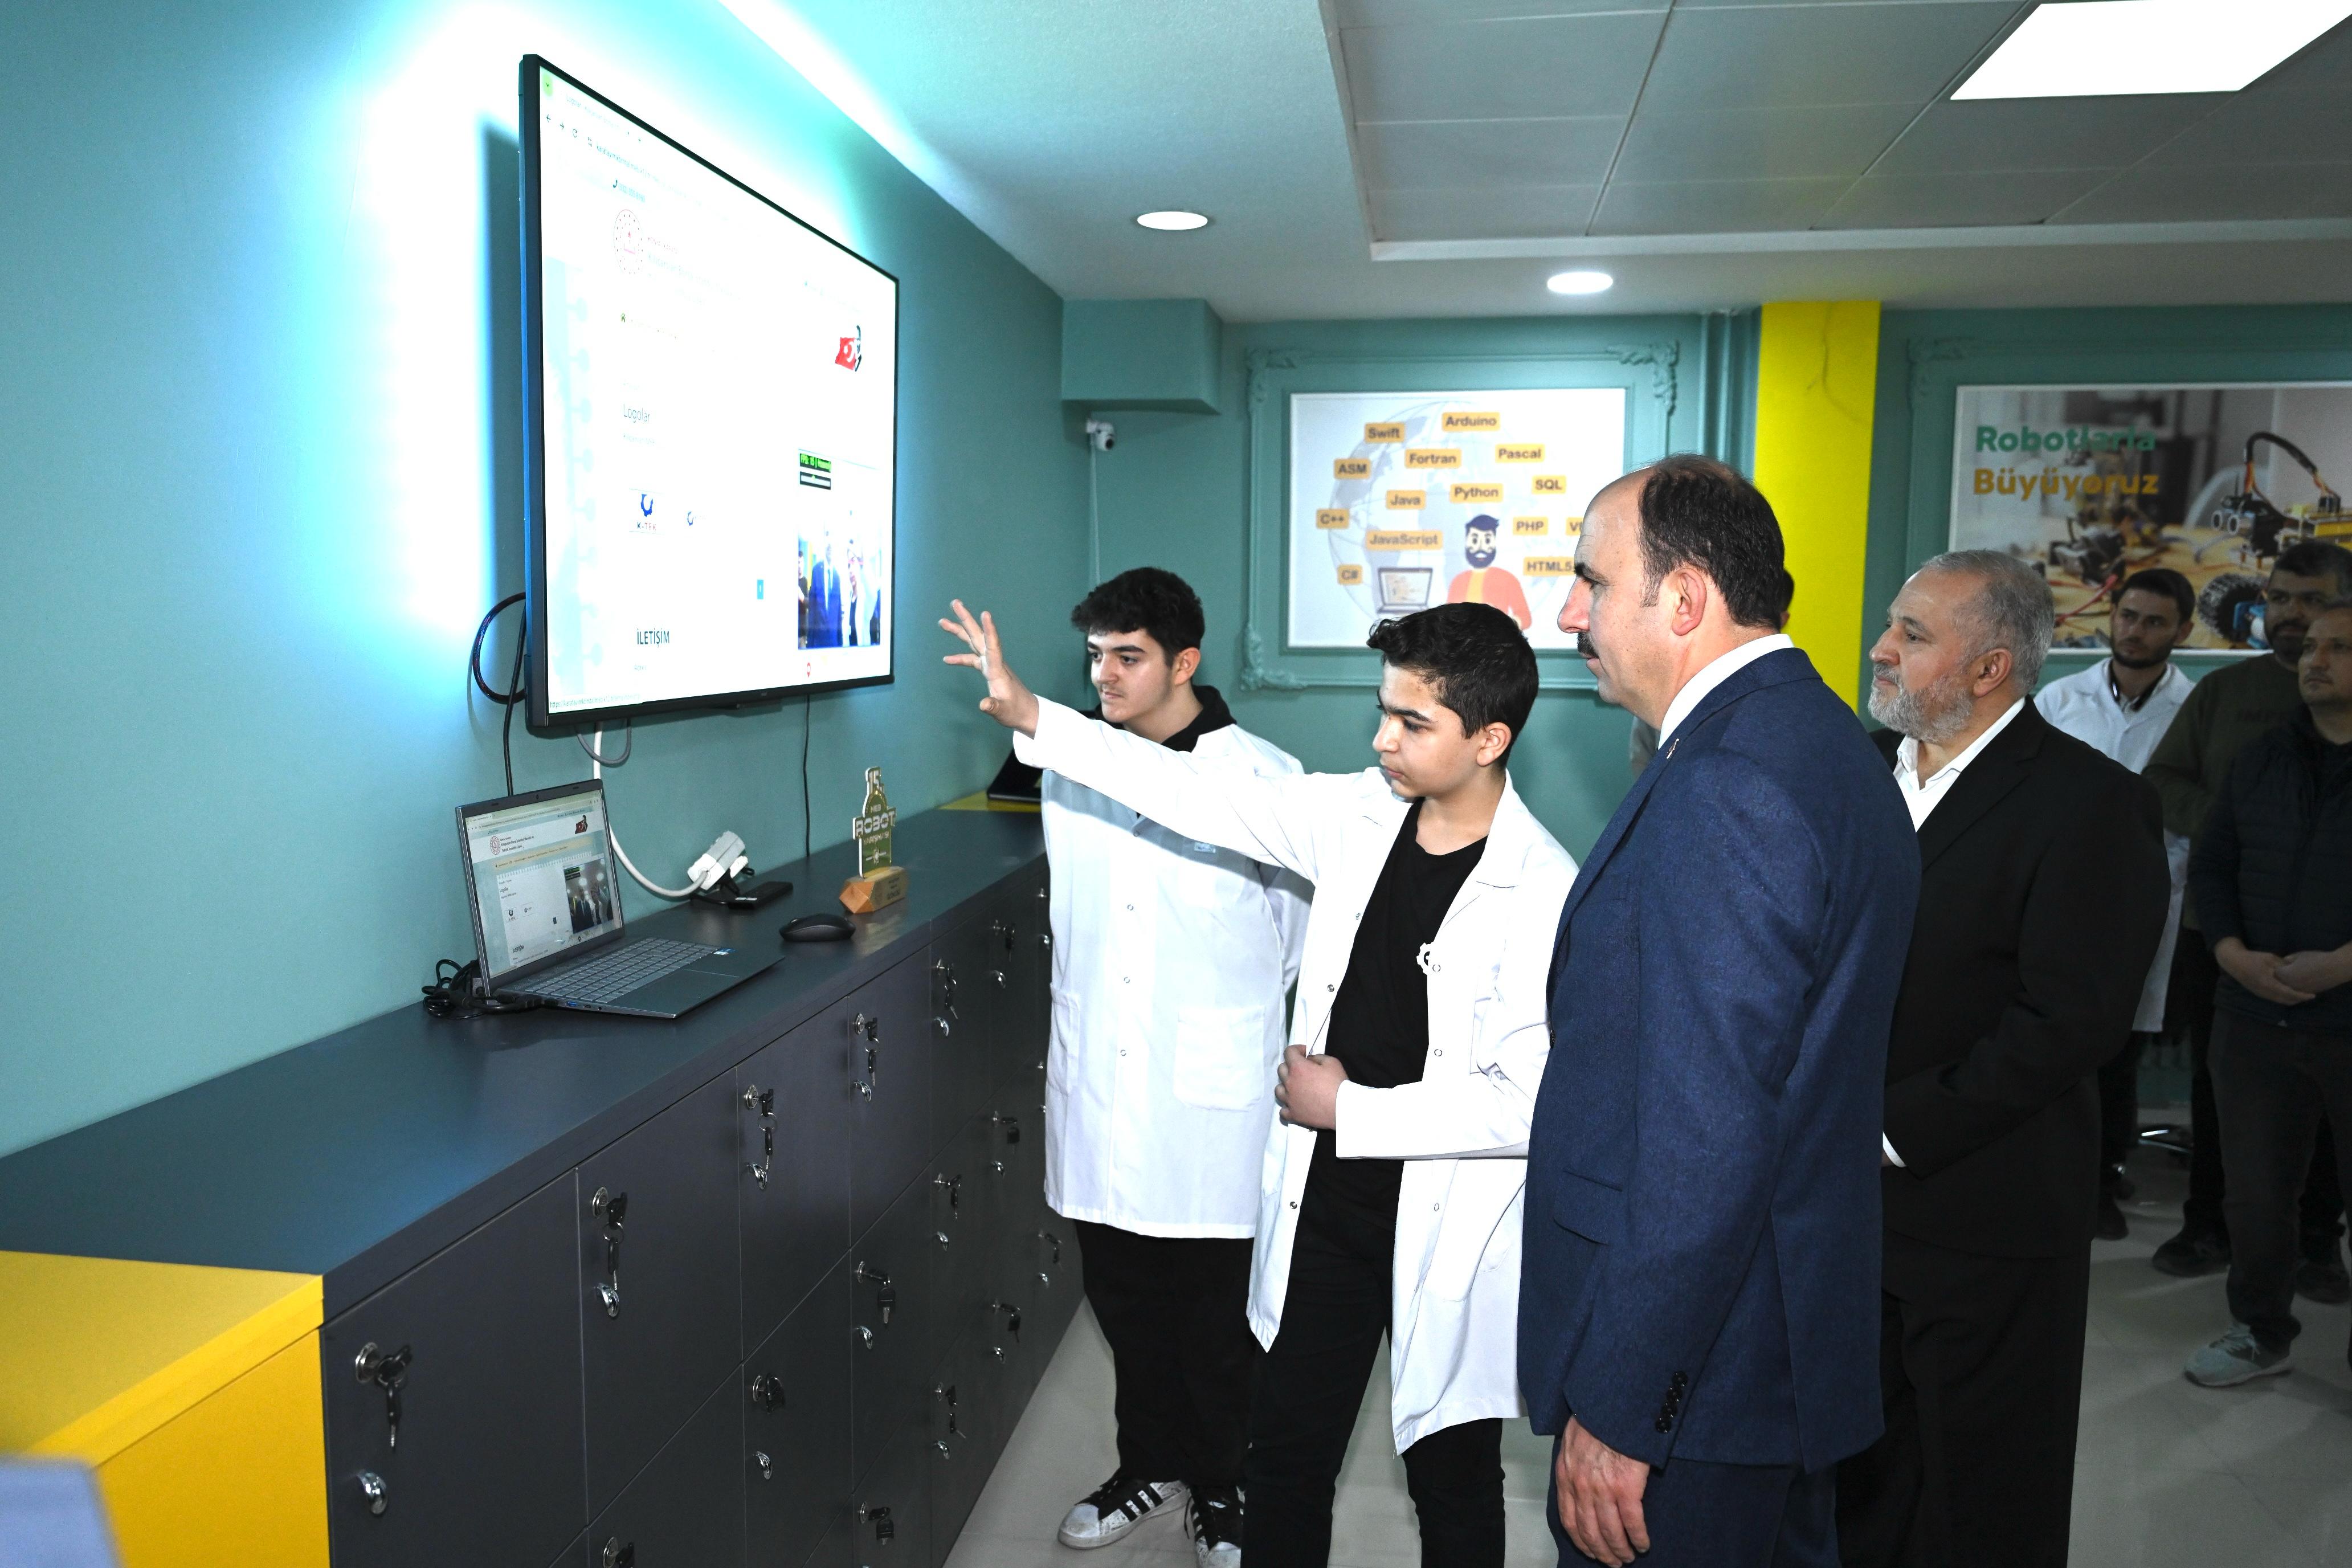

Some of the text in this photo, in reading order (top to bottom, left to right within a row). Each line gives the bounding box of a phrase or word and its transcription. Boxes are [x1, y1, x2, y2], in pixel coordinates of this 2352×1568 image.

[623, 403, 651, 423] Logolar
[1446, 416, 1497, 427] Arduino
[1368, 427, 1400, 439] Swift
[1975, 425, 2156, 452] Robotlarla
[1409, 453, 1457, 464] Fortran
[1498, 448, 1542, 459] Pascal
[1338, 463, 1367, 474] ASM
[1535, 479, 1562, 491] SQL
[1973, 467, 2159, 501] Büyüyoruz
[1454, 487, 1499, 500] Python
[1390, 494, 1420, 505] Java
[1320, 513, 1344, 524] C++
[1516, 521, 1544, 532] PHP
[1370, 533, 1438, 546] JavaScript
[1527, 561, 1573, 572] HTML5
[1342, 569, 1359, 579] C#
[637, 627, 670, 648] İLETİŞİM
[855, 810, 896, 836] ROBOT
